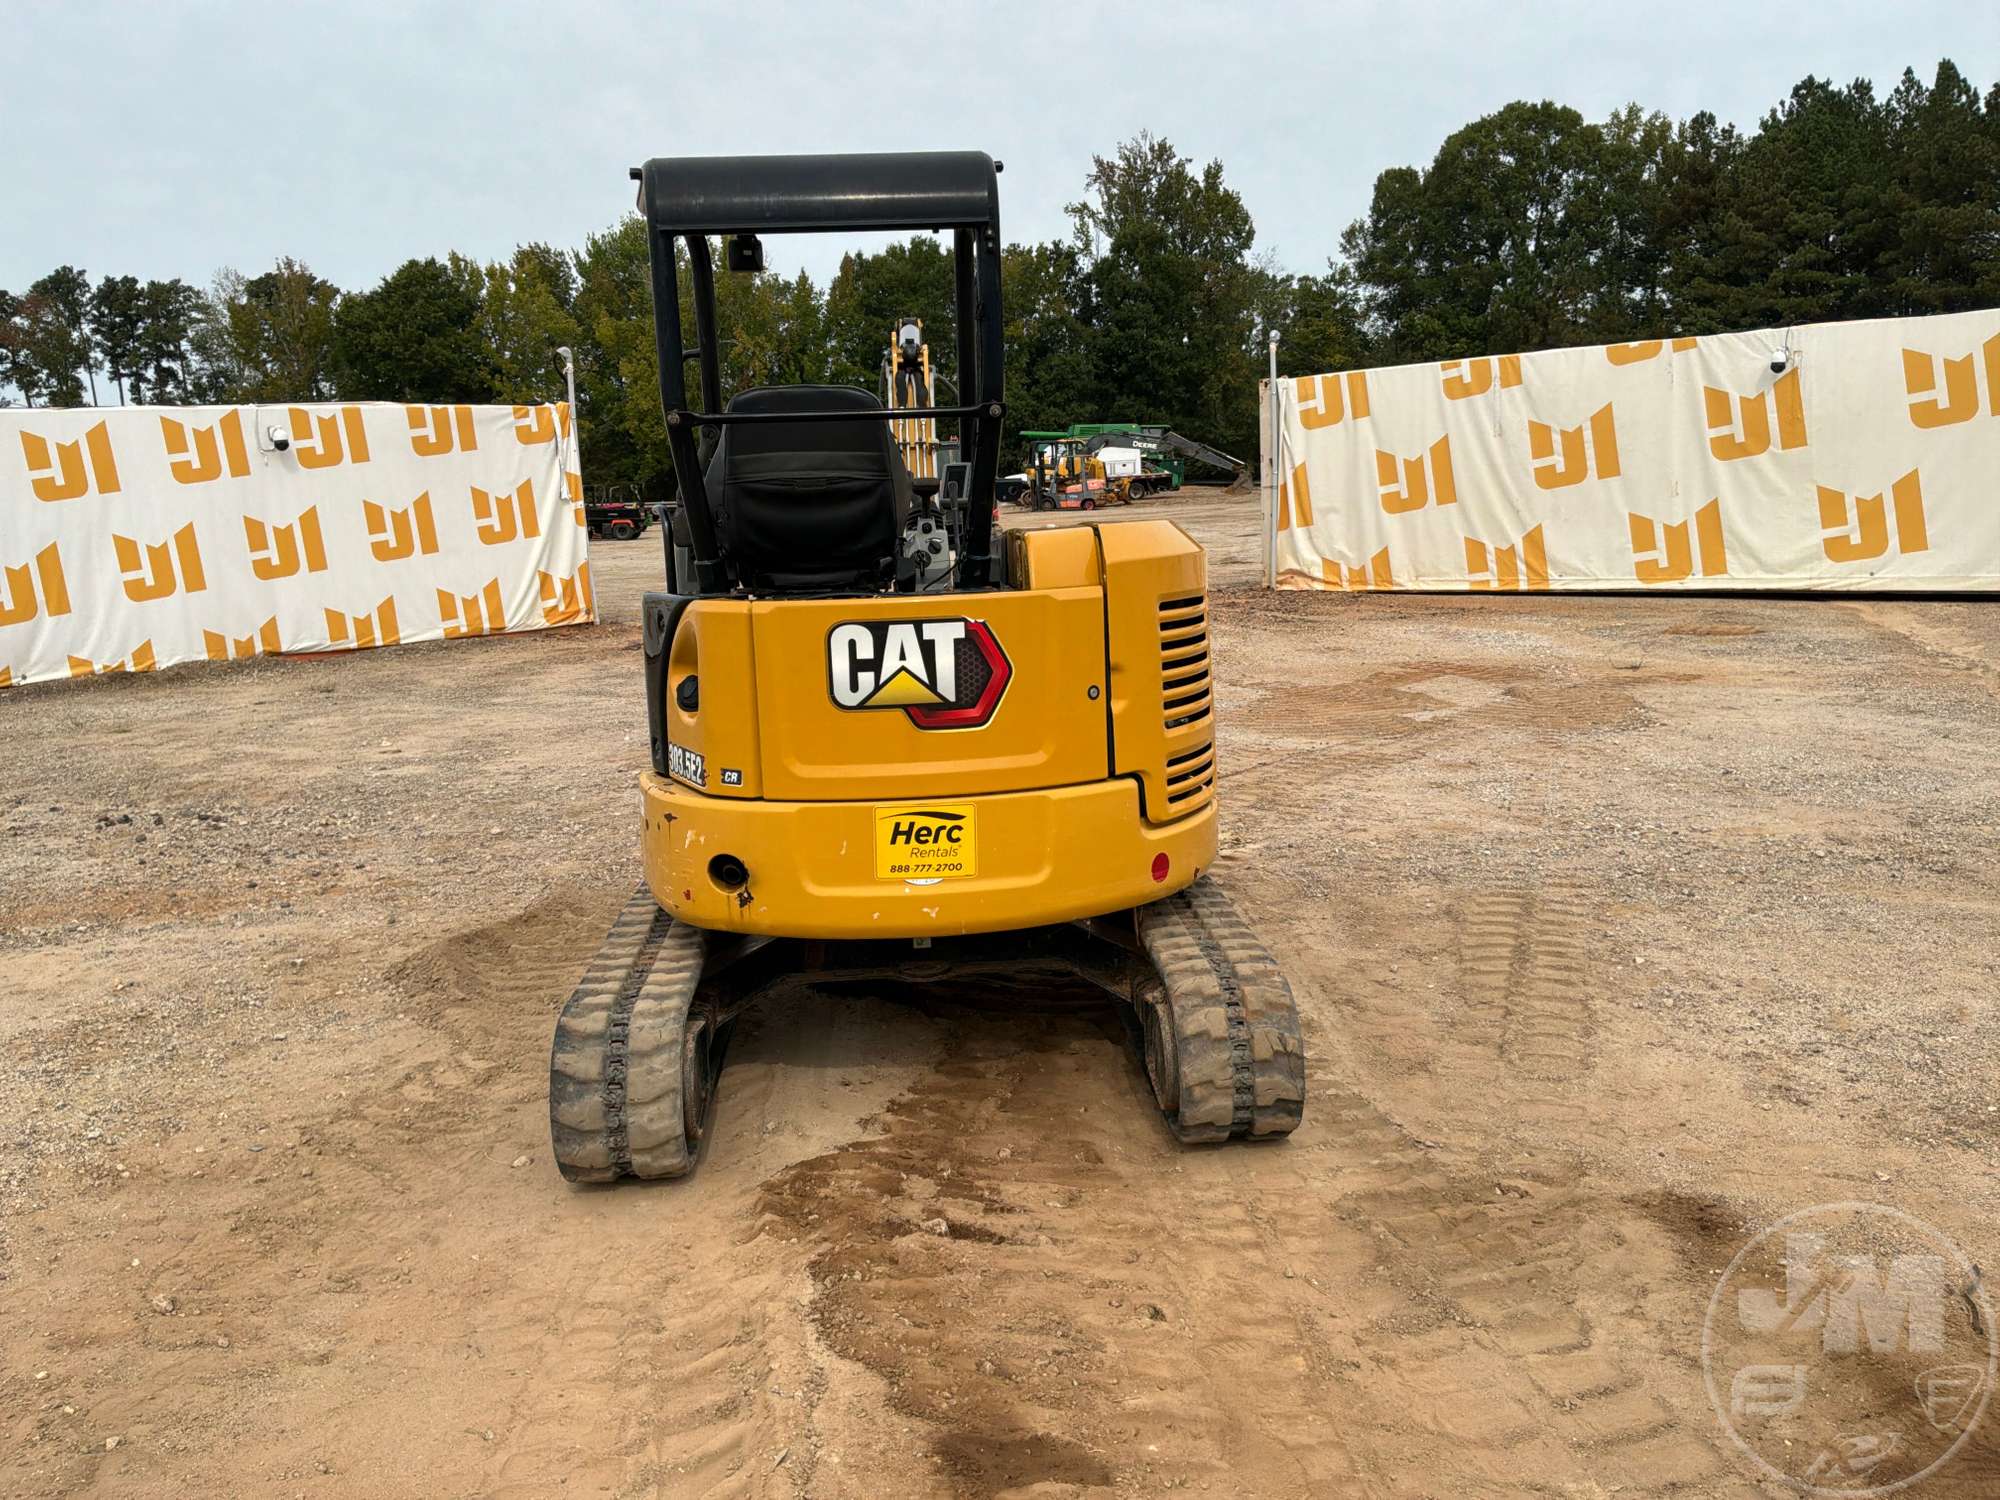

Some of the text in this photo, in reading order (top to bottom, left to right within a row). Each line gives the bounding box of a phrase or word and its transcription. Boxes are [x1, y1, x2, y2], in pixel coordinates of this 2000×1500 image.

[1132, 440, 1158, 449] DEERE
[830, 621, 966, 707] CAT
[724, 771, 738, 783] CR
[890, 821, 964, 845] Herc
[910, 847, 958, 858] Rentals
[890, 863, 963, 873] 888-777-2700
